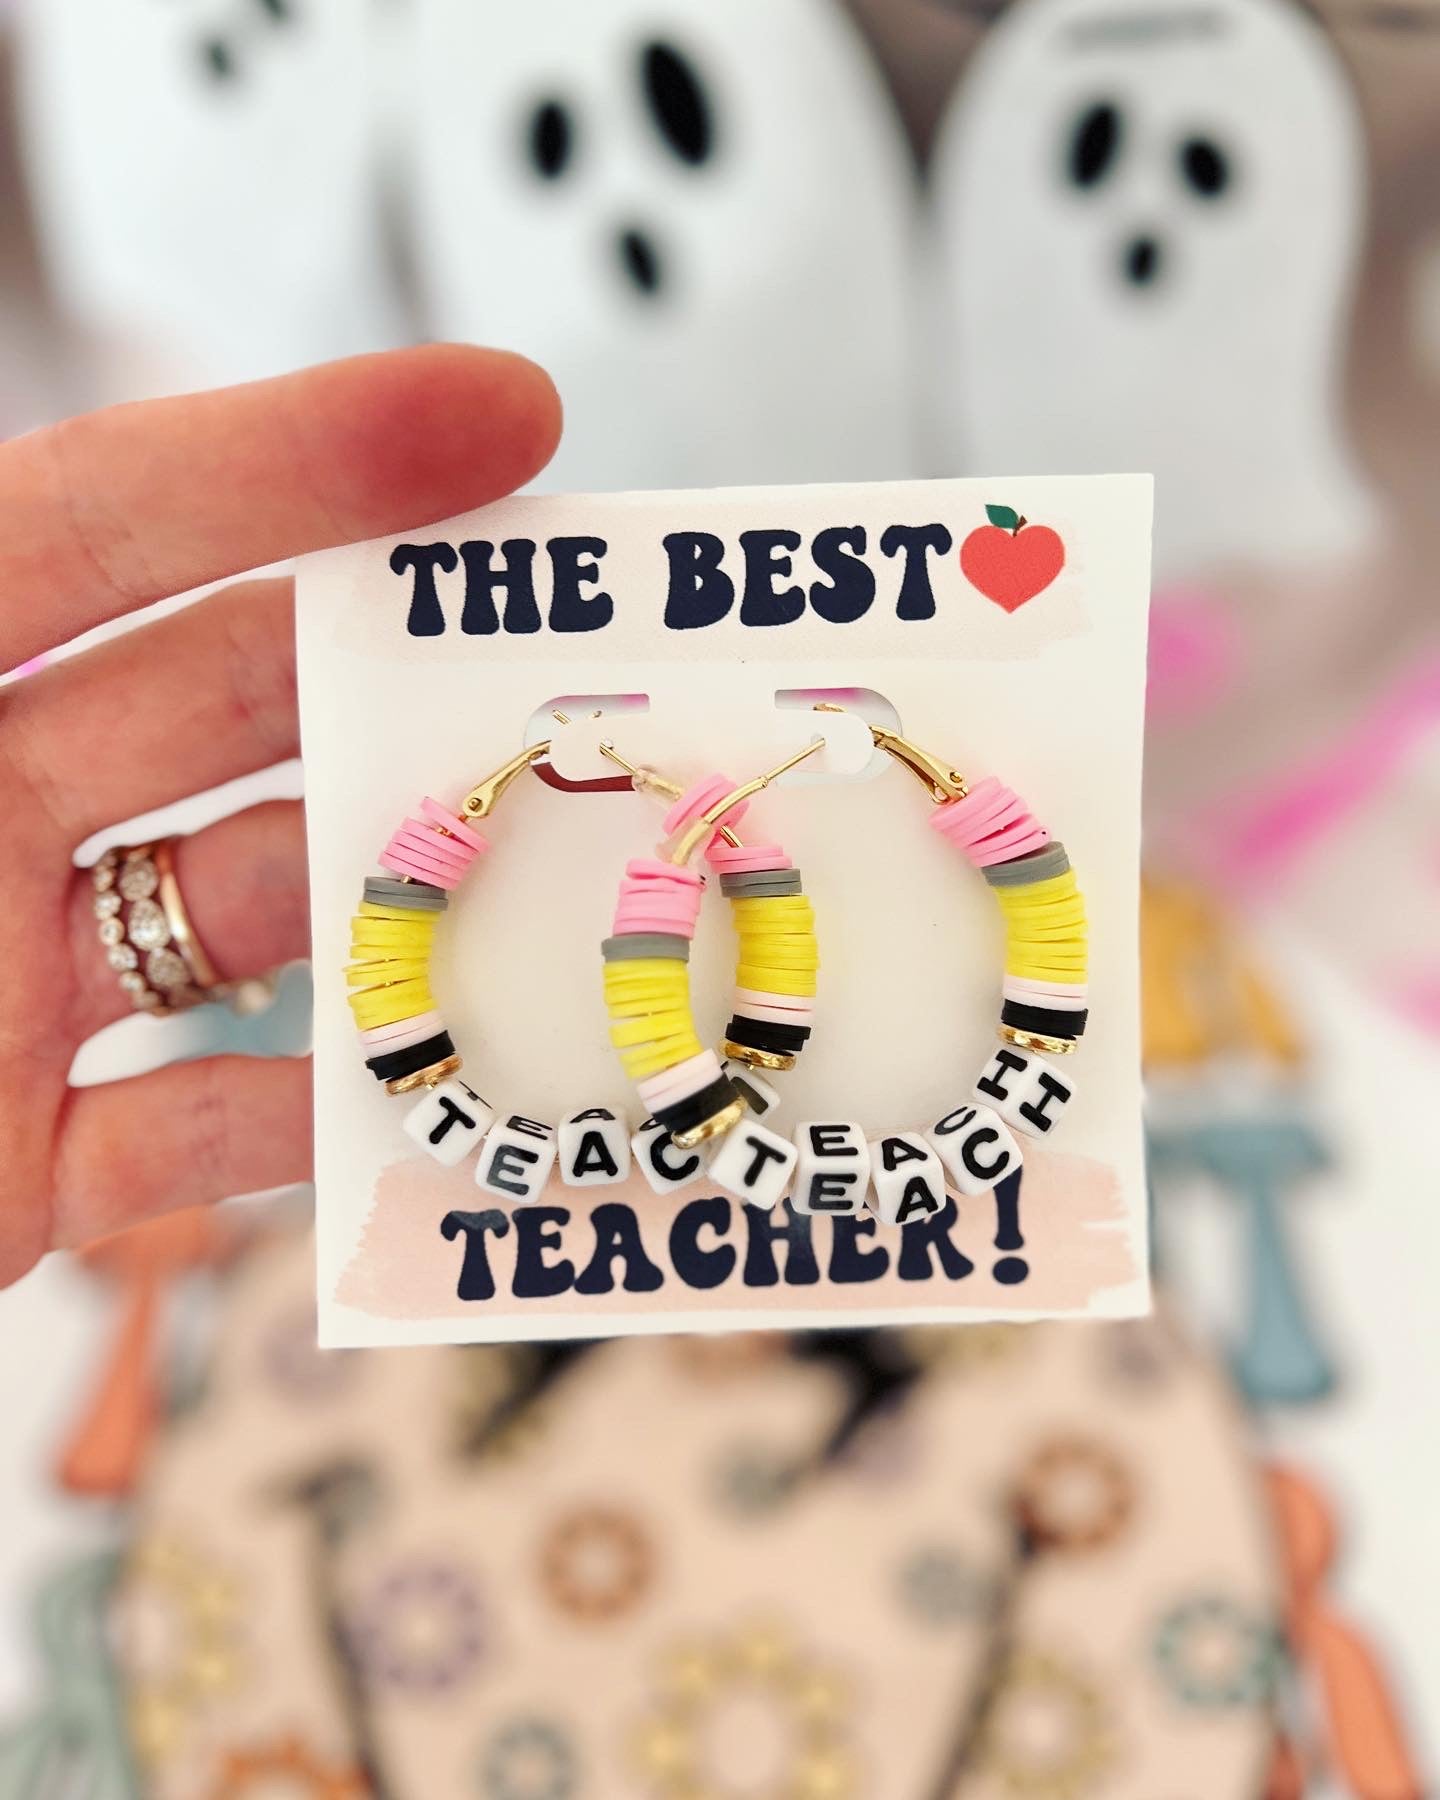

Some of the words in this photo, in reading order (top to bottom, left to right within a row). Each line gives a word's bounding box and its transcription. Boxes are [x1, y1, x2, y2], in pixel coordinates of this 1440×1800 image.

[389, 536, 614, 636] THE
[662, 523, 953, 630] BEST
[744, 1071, 1072, 1224] TEACH
[440, 1165, 1030, 1301] TEACHER!
